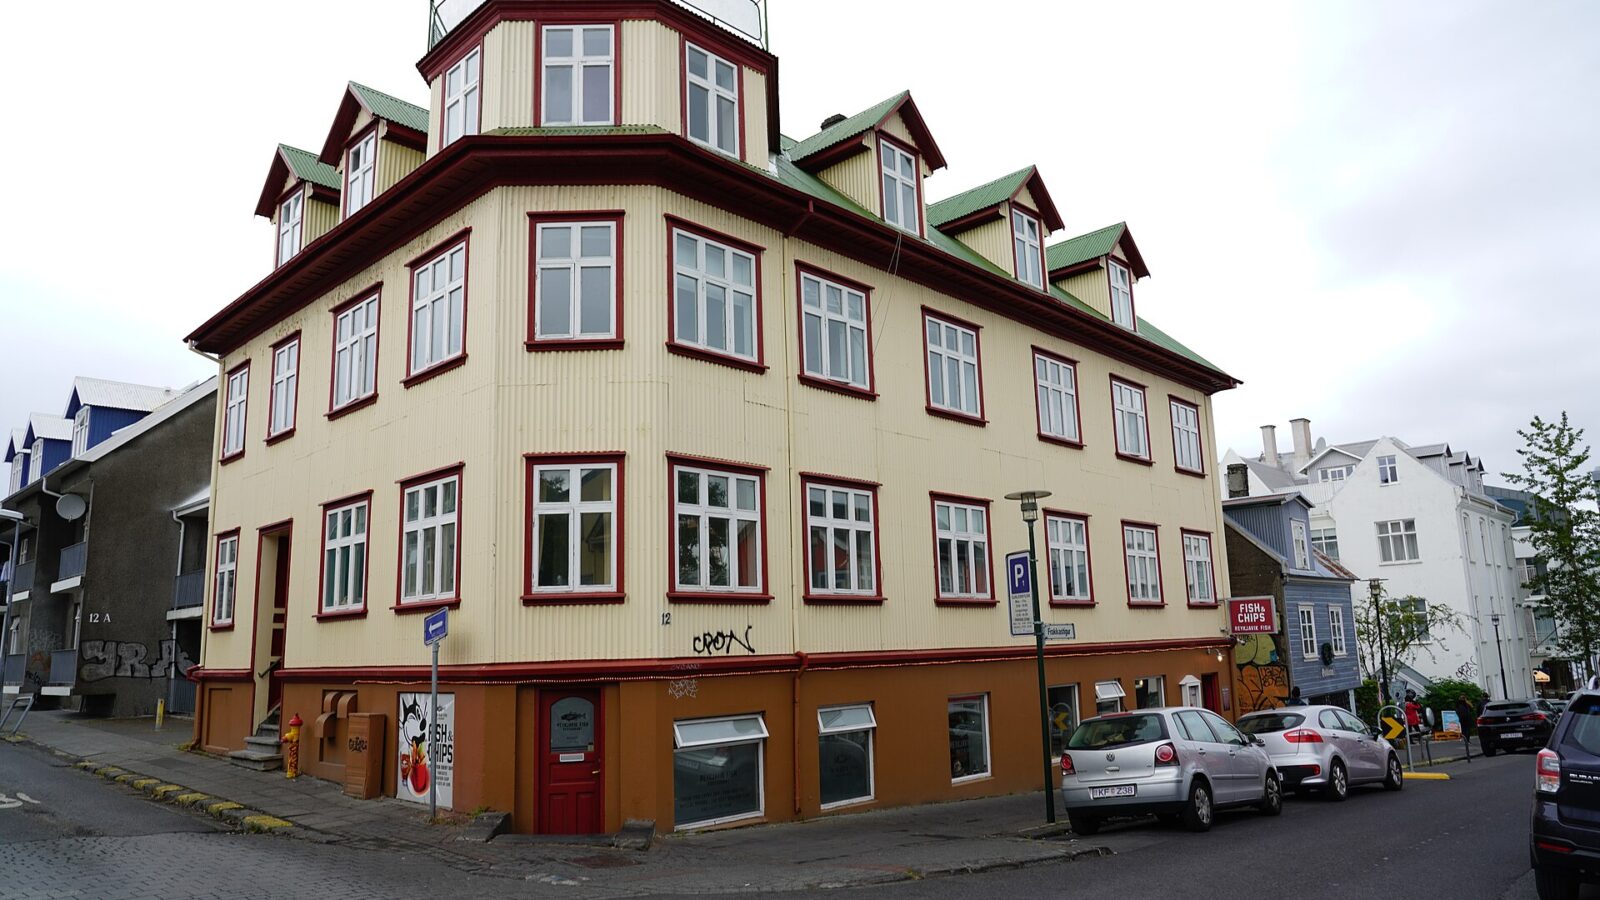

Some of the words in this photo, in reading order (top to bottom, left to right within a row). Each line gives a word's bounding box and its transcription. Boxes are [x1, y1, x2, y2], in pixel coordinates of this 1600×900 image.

[1014, 564, 1024, 587] P
[89, 613, 100, 623] 12
[103, 613, 111, 623] A
[662, 612, 671, 625] 12
[1238, 613, 1266, 623] CHIPS
